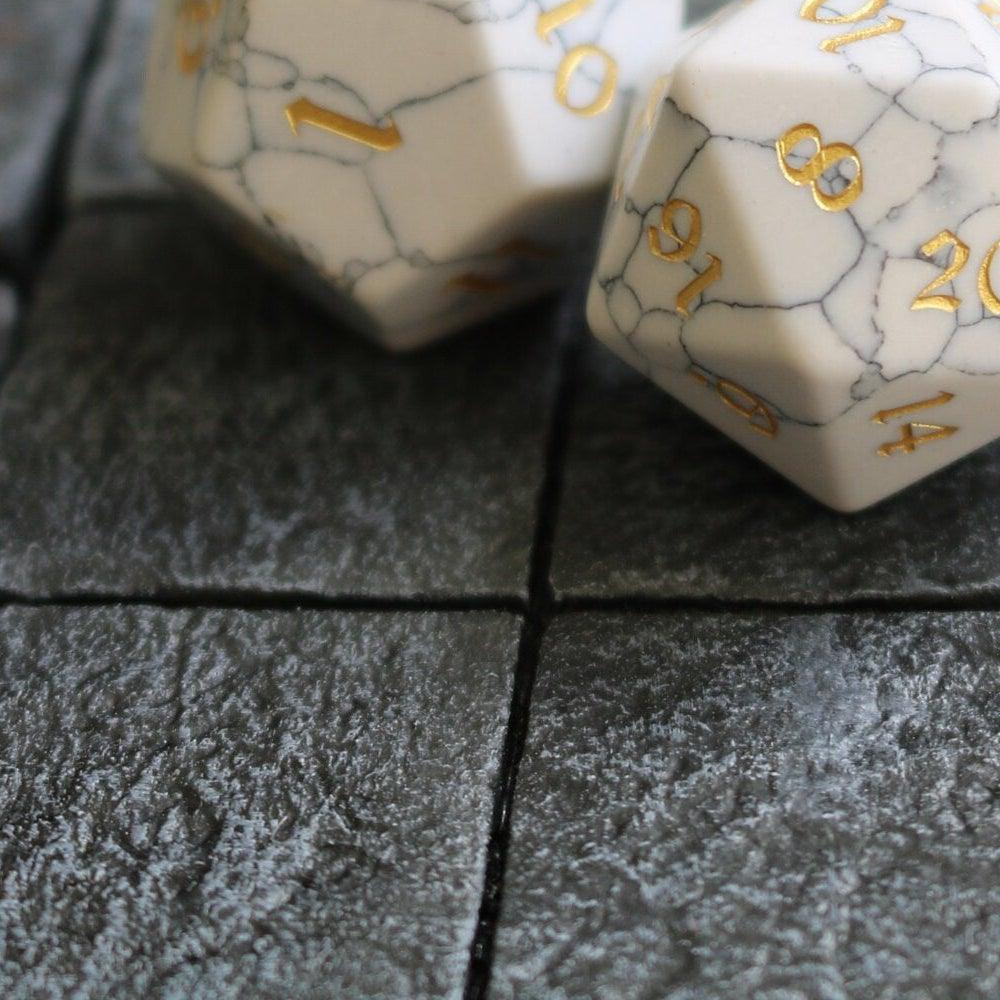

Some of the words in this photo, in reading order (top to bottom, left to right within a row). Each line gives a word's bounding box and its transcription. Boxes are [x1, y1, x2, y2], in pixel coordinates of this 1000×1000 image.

[284, 96, 401, 152] 1
[775, 122, 865, 213] 8
[869, 391, 961, 458] 14
